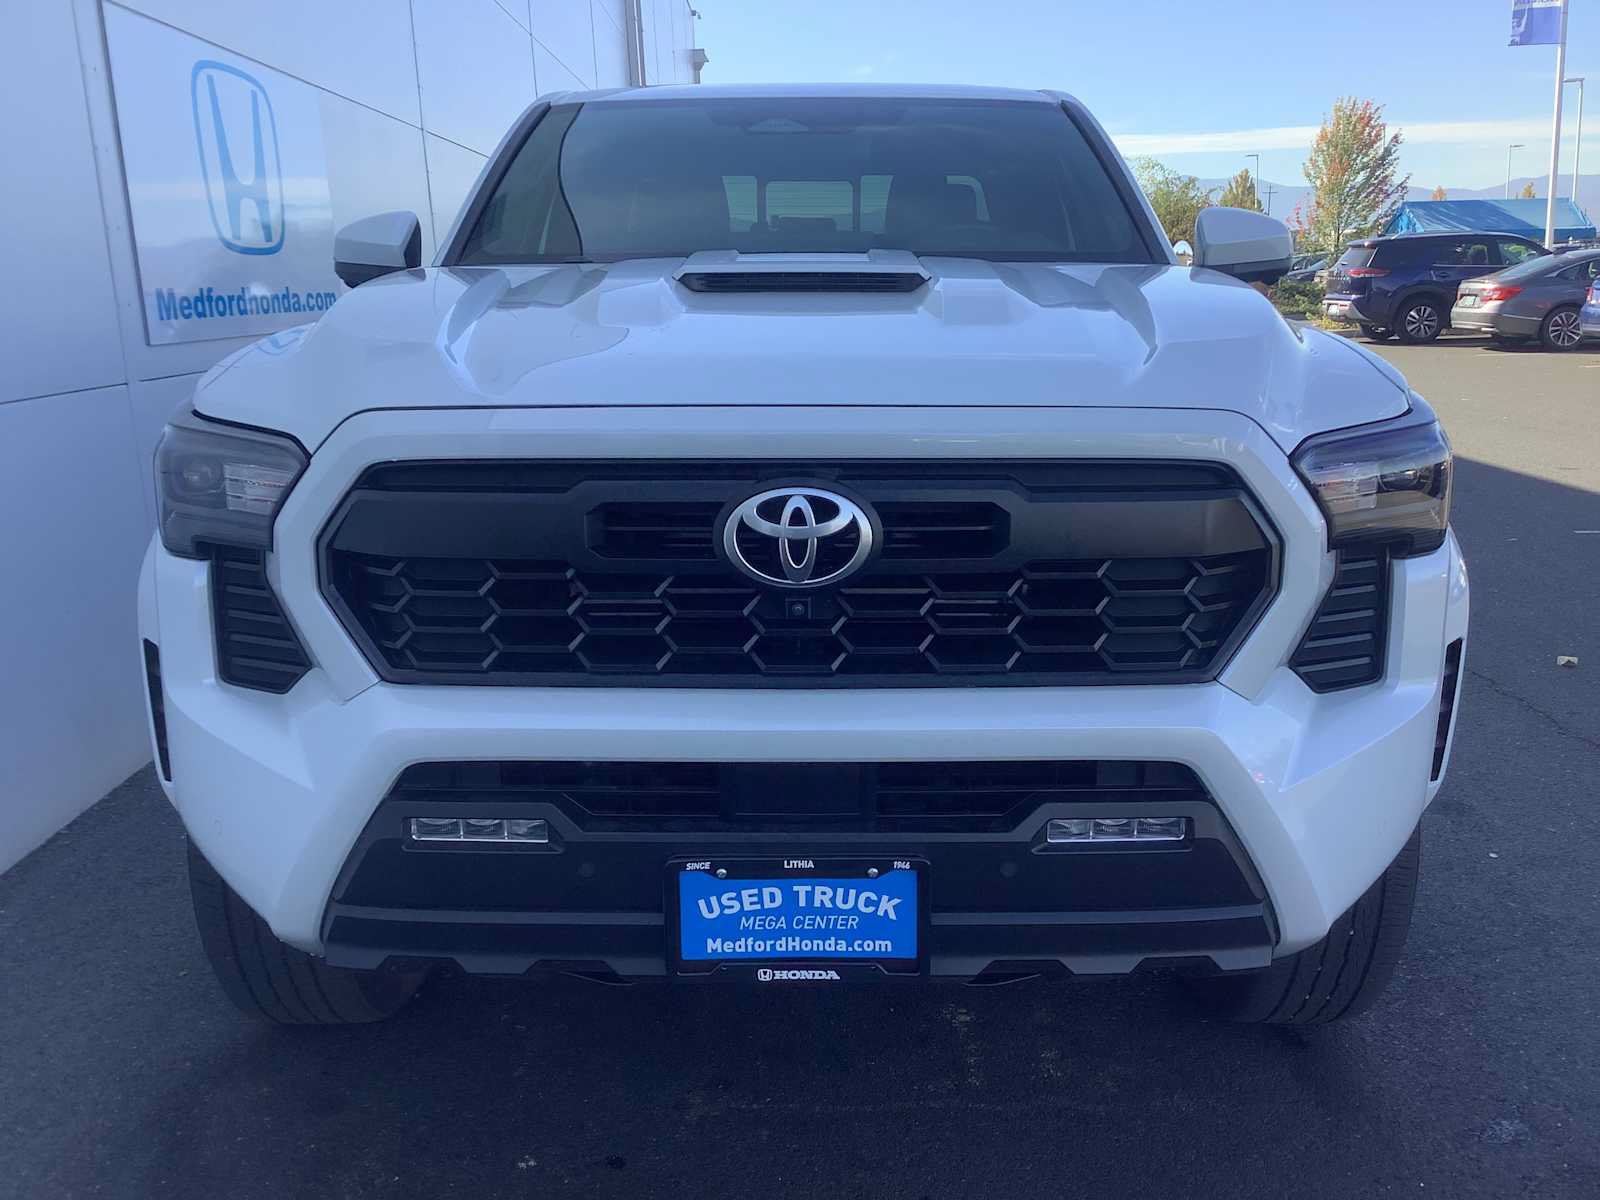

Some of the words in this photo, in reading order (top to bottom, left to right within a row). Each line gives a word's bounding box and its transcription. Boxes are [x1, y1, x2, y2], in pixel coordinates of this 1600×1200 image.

[686, 861, 711, 870] SINCE
[784, 860, 814, 869] LITHIA
[698, 886, 783, 919] USED
[793, 885, 902, 920] TRUCK
[740, 917, 787, 930] MEGA
[793, 916, 859, 929] CENTER
[706, 937, 892, 953] MedfordHonda.com
[773, 970, 840, 980] HONDA
